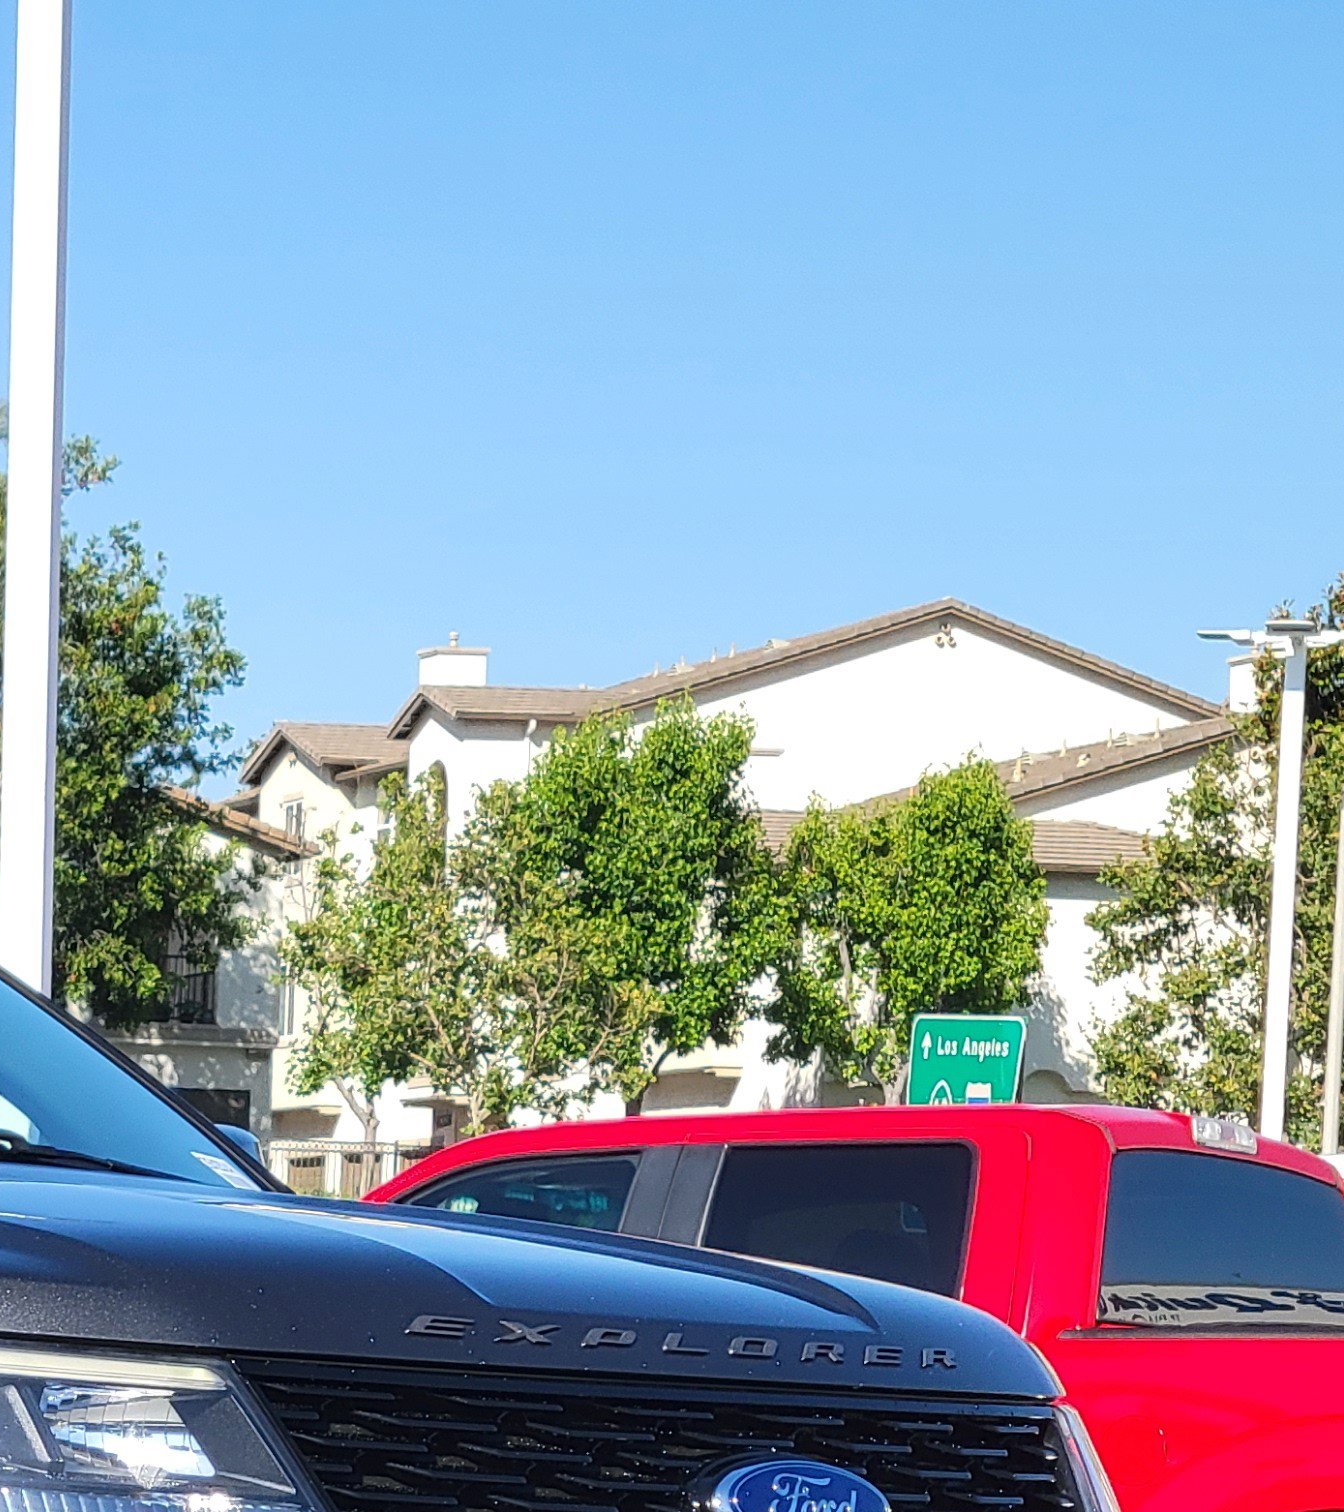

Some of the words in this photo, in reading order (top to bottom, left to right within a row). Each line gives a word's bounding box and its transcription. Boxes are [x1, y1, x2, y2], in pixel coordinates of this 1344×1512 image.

[936, 1035, 958, 1056] Los
[962, 1036, 1010, 1063] Angeles
[405, 1315, 958, 1369] EXPLORER
